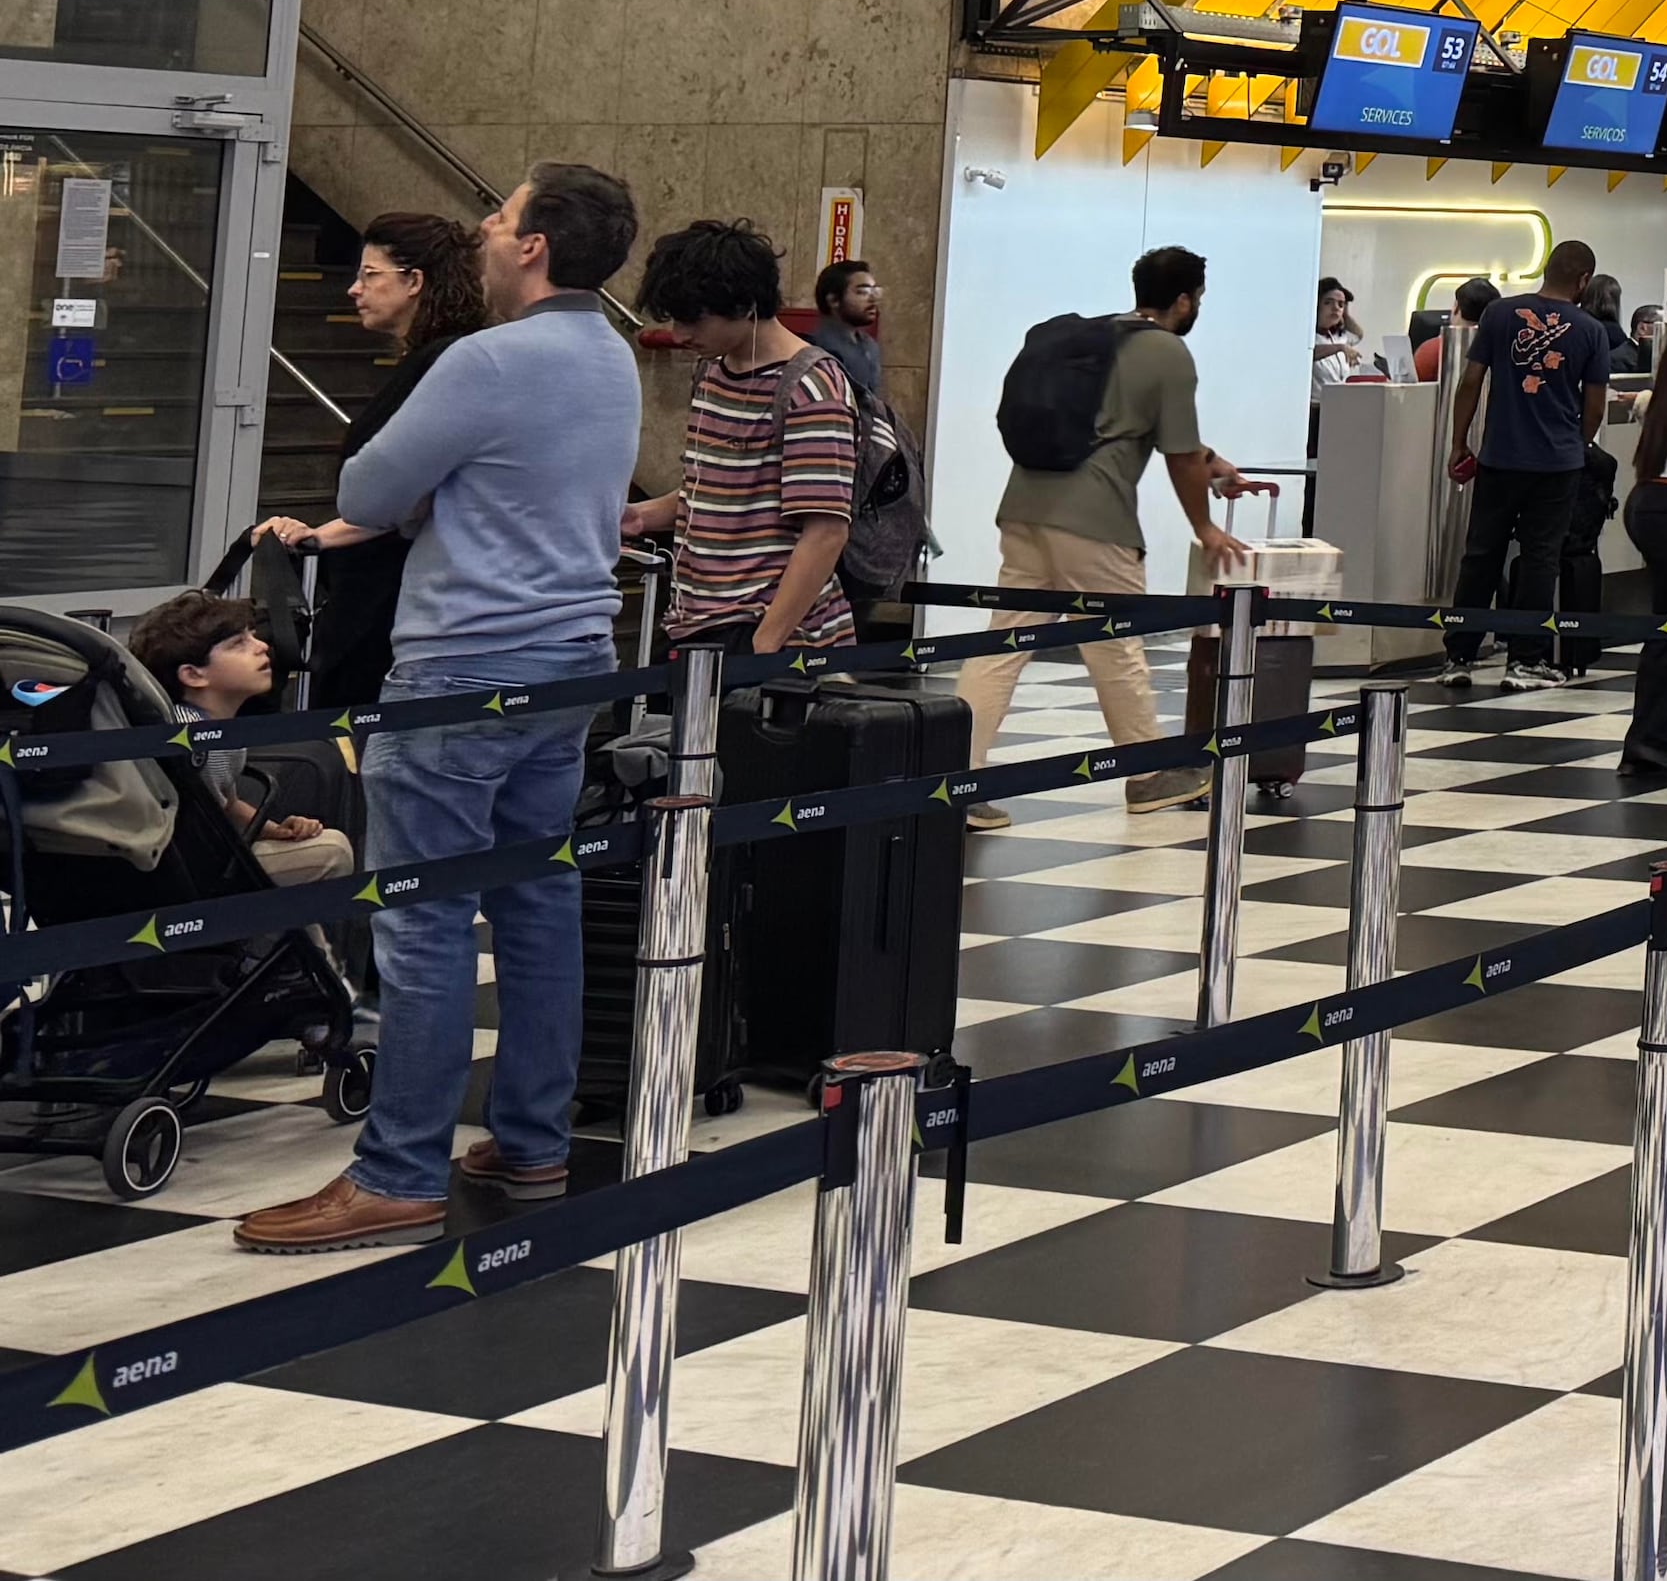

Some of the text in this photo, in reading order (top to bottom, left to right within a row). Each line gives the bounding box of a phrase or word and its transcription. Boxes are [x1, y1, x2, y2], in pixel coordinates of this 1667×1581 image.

[1361, 27, 1401, 58] GOL
[1442, 37, 1465, 61] 53
[1587, 54, 1618, 81] GOL
[1651, 61, 1667, 83] 54
[1360, 106, 1413, 126] SERVICES
[1582, 125, 1627, 143] SERVIÇOS
[193, 729, 223, 742] aena
[16, 745, 49, 758] aena
[796, 805, 826, 820] aena
[576, 839, 609, 856] aena
[384, 877, 420, 895] aena
[164, 918, 204, 937] aena
[1485, 959, 1512, 979] aena
[1142, 1056, 1176, 1078] aena
[477, 1239, 532, 1273] aena
[112, 1350, 178, 1388] aena
